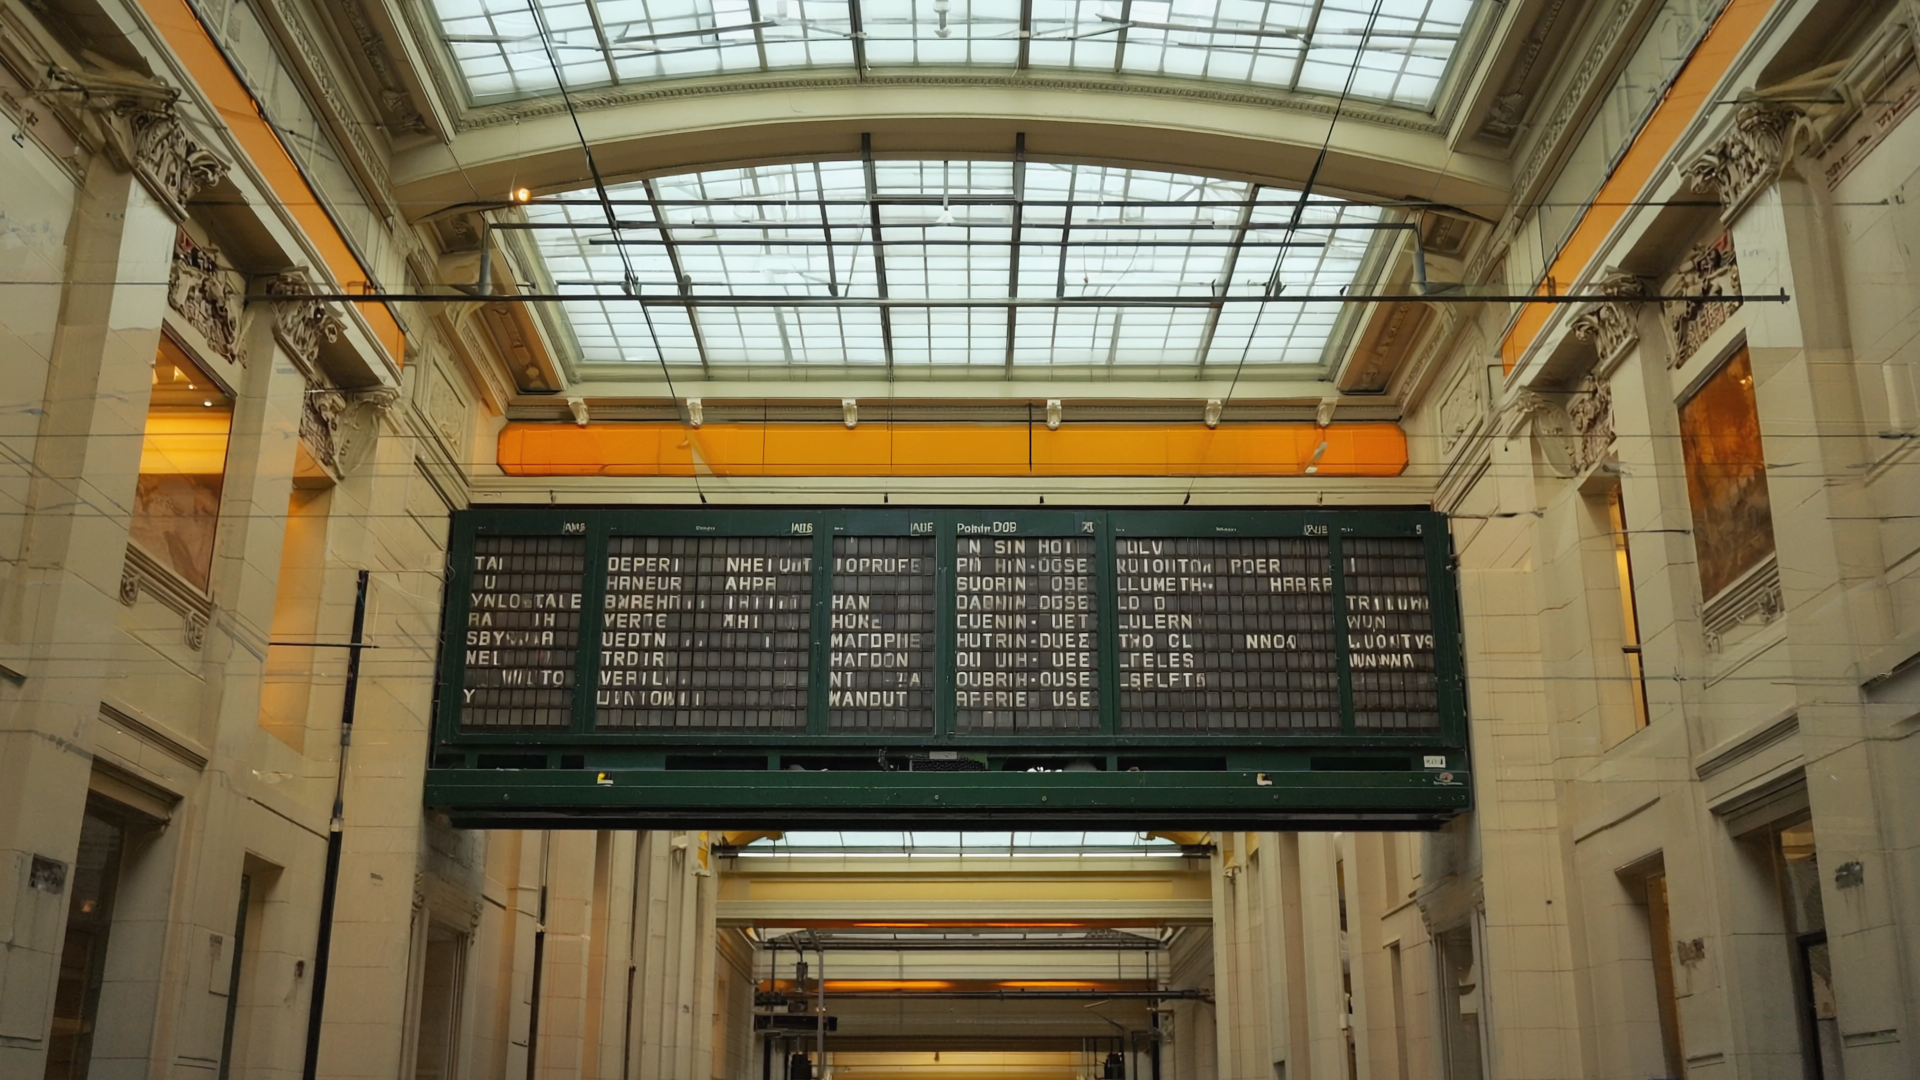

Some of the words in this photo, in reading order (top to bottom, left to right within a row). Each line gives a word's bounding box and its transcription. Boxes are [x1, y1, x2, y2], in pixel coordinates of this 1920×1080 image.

[995, 540, 1025, 554] SIN
[832, 595, 870, 610] HAN
[463, 689, 476, 703] Y
